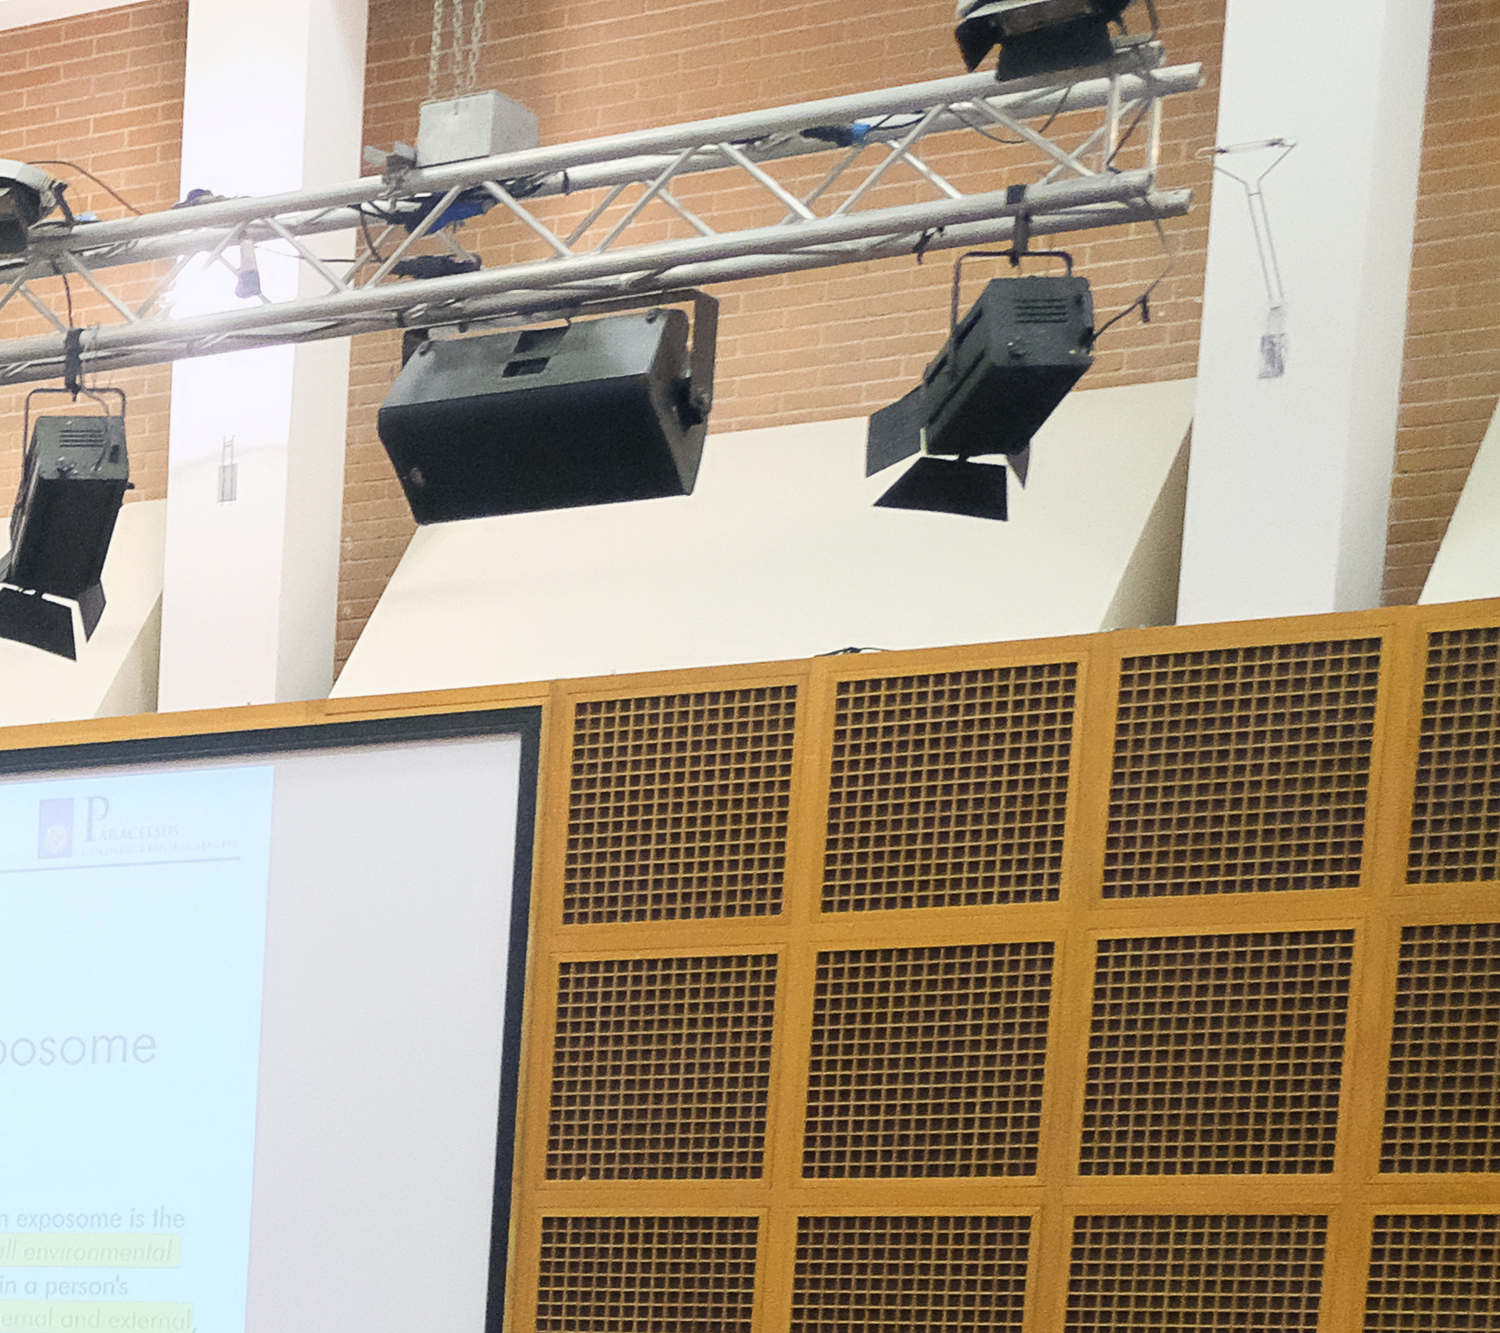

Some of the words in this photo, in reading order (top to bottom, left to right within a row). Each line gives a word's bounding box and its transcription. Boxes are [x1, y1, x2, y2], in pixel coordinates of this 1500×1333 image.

[16, 1210, 122, 1232] exposome
[129, 1207, 145, 1228] is
[152, 1205, 186, 1229] the
[23, 1239, 173, 1262] environmental
[0, 1275, 16, 1295] in
[24, 1280, 37, 1295] a
[45, 1275, 129, 1299] person's
[60, 1308, 100, 1329] and
